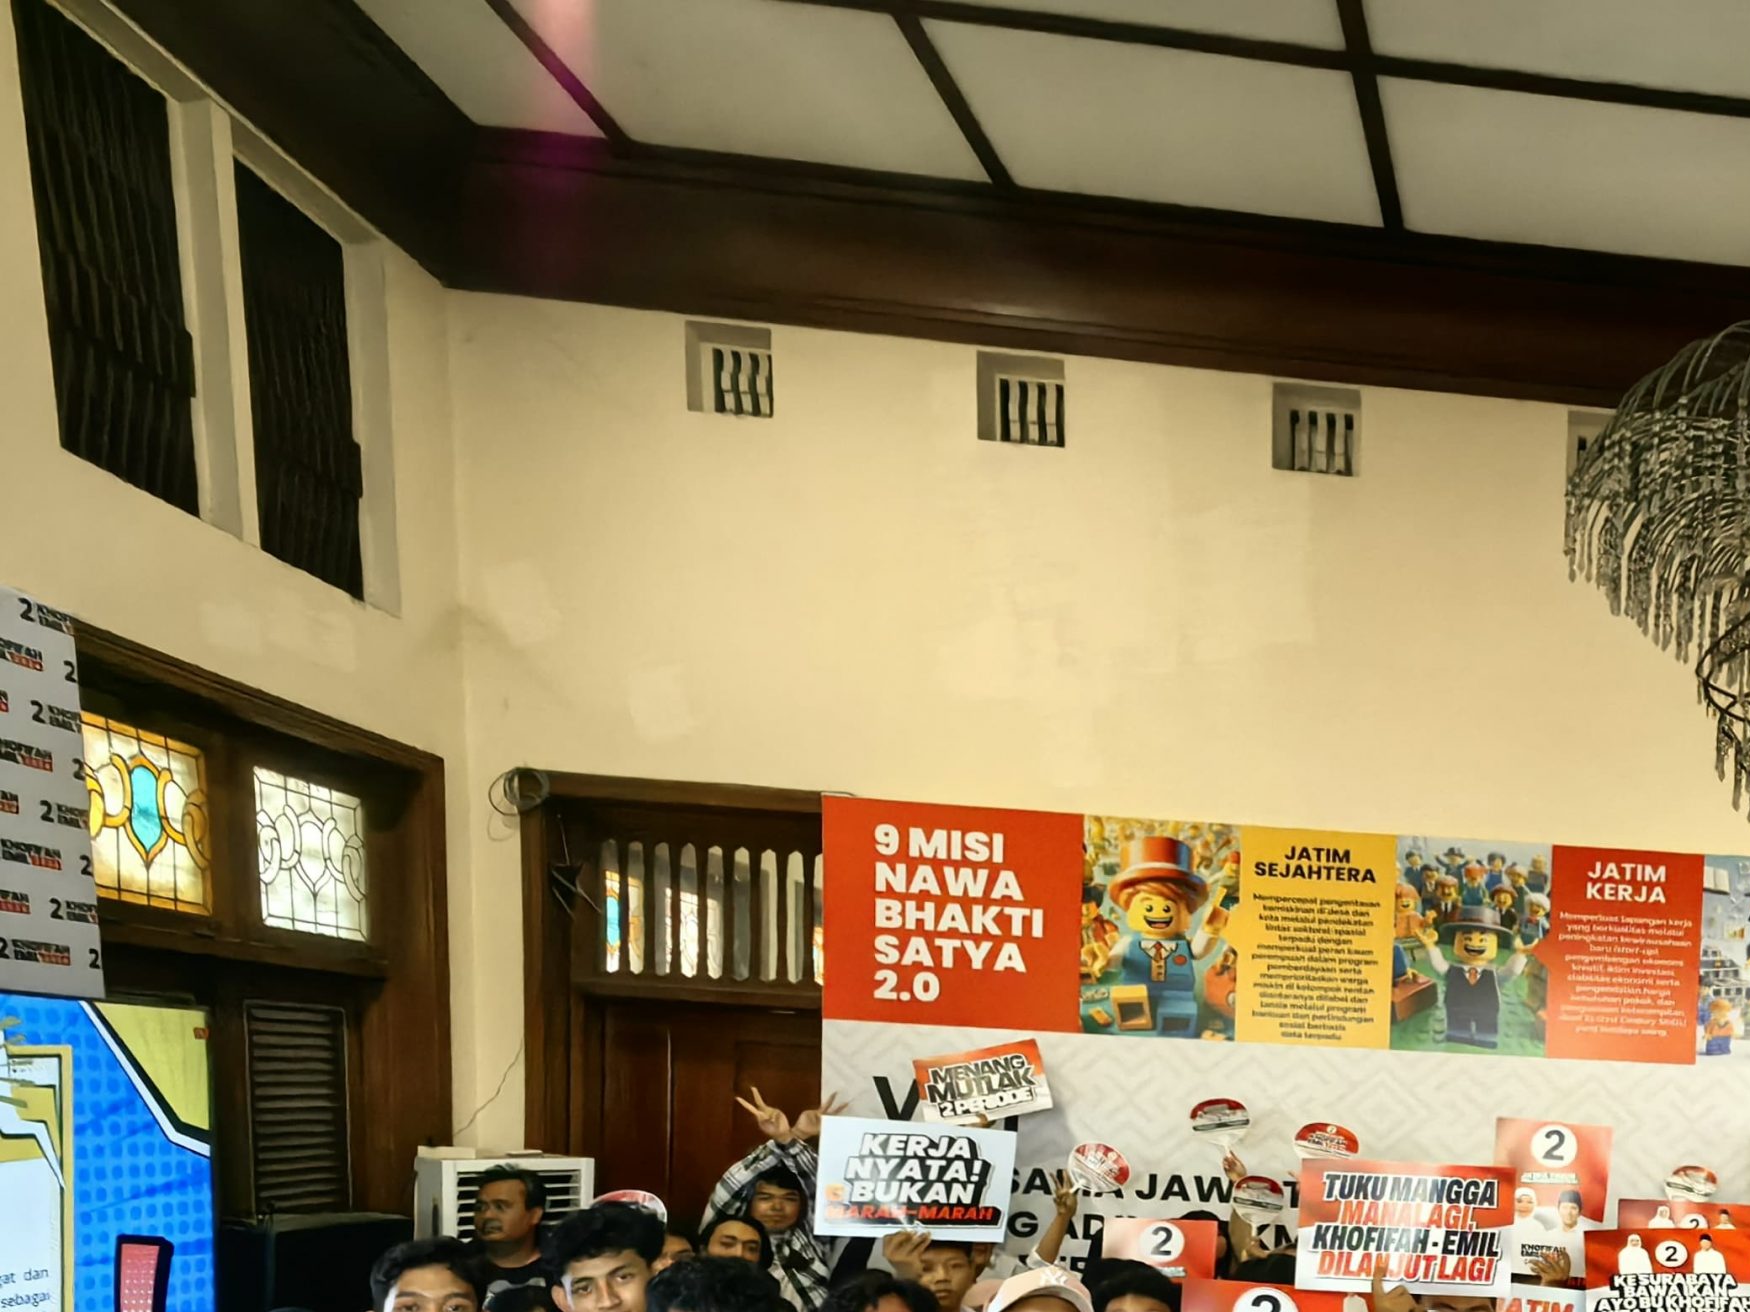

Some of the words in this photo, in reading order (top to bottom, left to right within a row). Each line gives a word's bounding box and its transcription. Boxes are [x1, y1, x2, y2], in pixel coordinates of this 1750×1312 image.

[18, 598, 35, 622] 2
[63, 660, 77, 683] 2
[30, 700, 47, 724] 2
[72, 758, 86, 780] 2
[40, 800, 54, 823] 2
[874, 824, 899, 855] 9
[909, 826, 1004, 863] MISI
[1285, 846, 1350, 864] JATIM
[80, 855, 94, 877] 2
[1254, 862, 1376, 884] SEJAHTERA
[1587, 861, 1666, 883] JATIM
[874, 862, 1024, 900] NAWA
[1586, 882, 1666, 904] KERJA
[49, 898, 64, 920] 2
[874, 898, 1044, 938] BHAKTI
[88, 949, 101, 969] 2
[873, 935, 1027, 973] SATYA
[873, 970, 940, 1002] 2.0
[930, 1053, 1025, 1084] MENANG
[926, 1065, 1035, 1103] MUTLAK
[940, 1102, 954, 1118] 2
[860, 1133, 972, 1159] KERJA
[1543, 1129, 1566, 1161] 2
[846, 1157, 983, 1182] NYATA!
[850, 1181, 975, 1204] BUKAN
[1325, 1173, 1388, 1200] TUKU
[1389, 1176, 1497, 1207] MANGGA
[1340, 1200, 1477, 1234] MANALAGI,
[1151, 1225, 1173, 1256] 2
[1312, 1224, 1430, 1254] KHOFIFAH
[1442, 1228, 1499, 1258] EMIL
[1665, 1246, 1678, 1262] 2
[24, 1267, 49, 1283] dan
[1438, 1255, 1496, 1283] LAGI
[1614, 1274, 1637, 1288] KE
[1638, 1273, 1737, 1288] SURABAYA
[1599, 1298, 1640, 1312] AYO
[1642, 1298, 1667, 1310] BU
